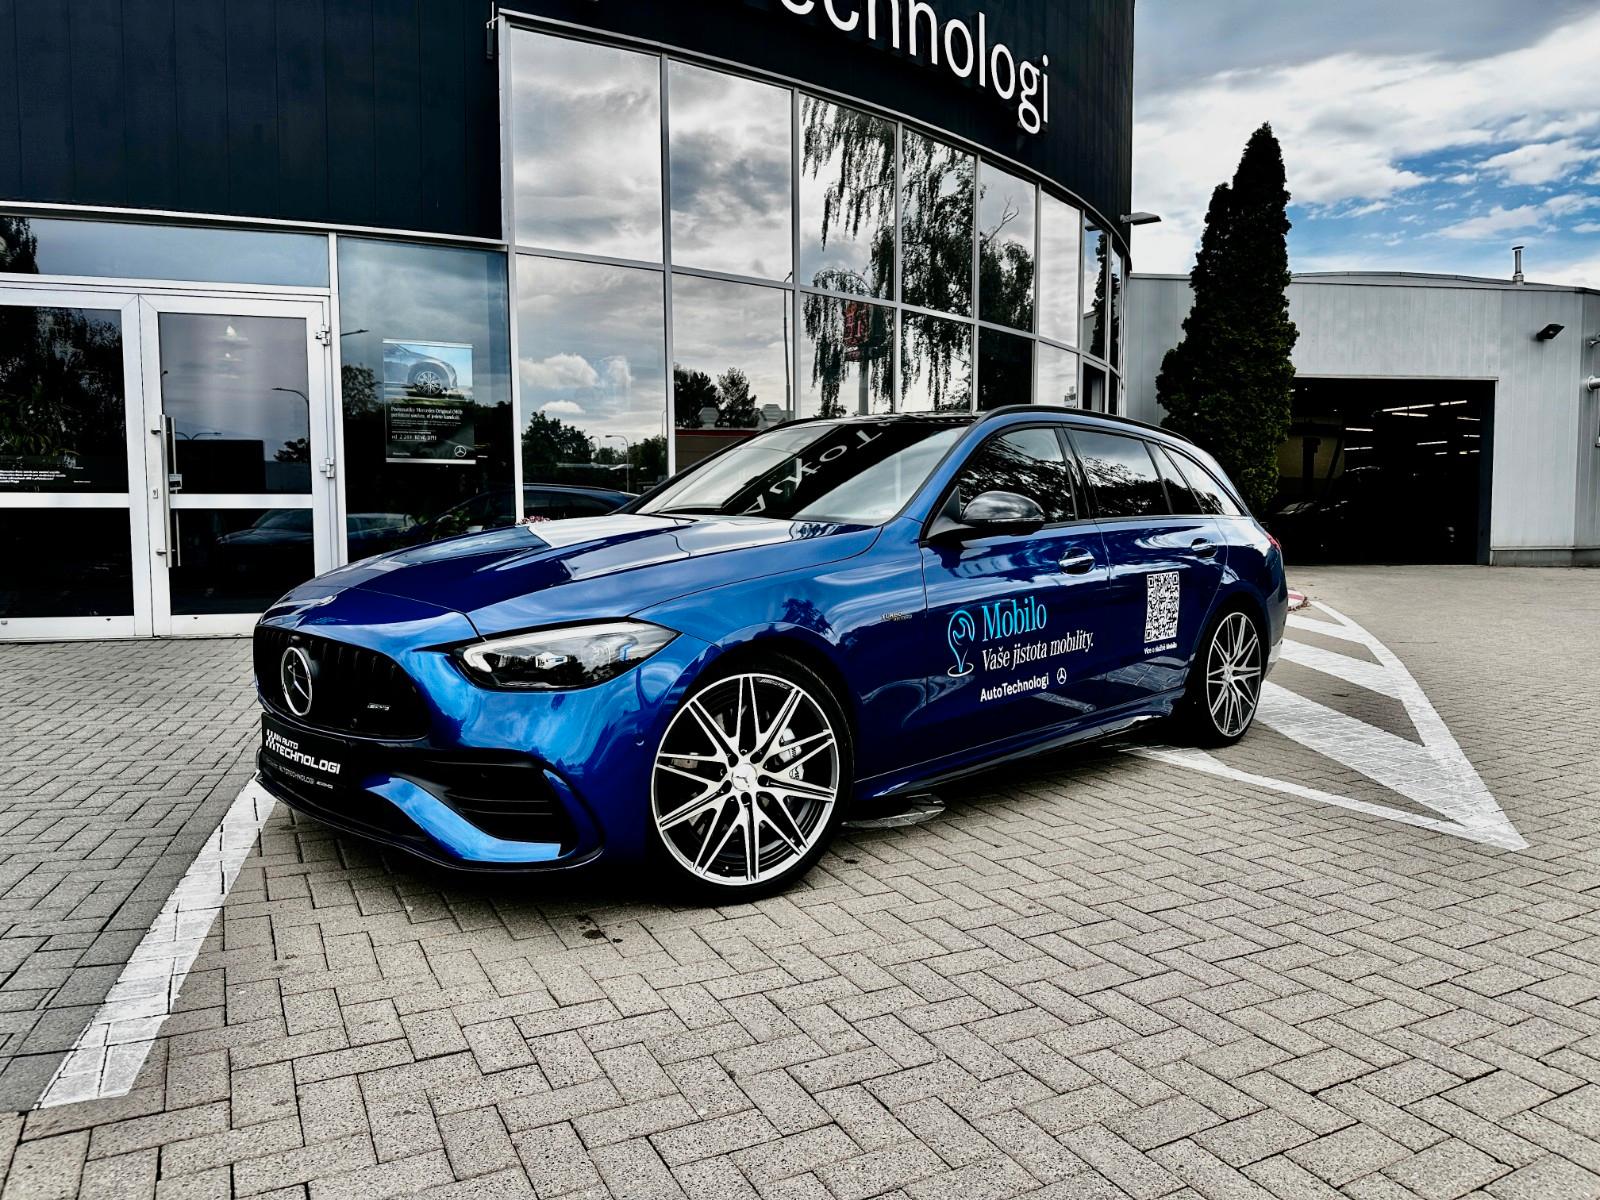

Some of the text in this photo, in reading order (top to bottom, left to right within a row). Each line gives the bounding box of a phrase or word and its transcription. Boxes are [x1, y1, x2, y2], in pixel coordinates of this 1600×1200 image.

[780, 0, 1049, 134] chnologi
[982, 595, 1047, 642] Mobilo
[982, 629, 1094, 672] Vaše jistota mobility.
[980, 672, 1049, 702] AutoTechnologi
[275, 743, 341, 775] TECHNOLOGI
[281, 737, 299, 750] AUTO
